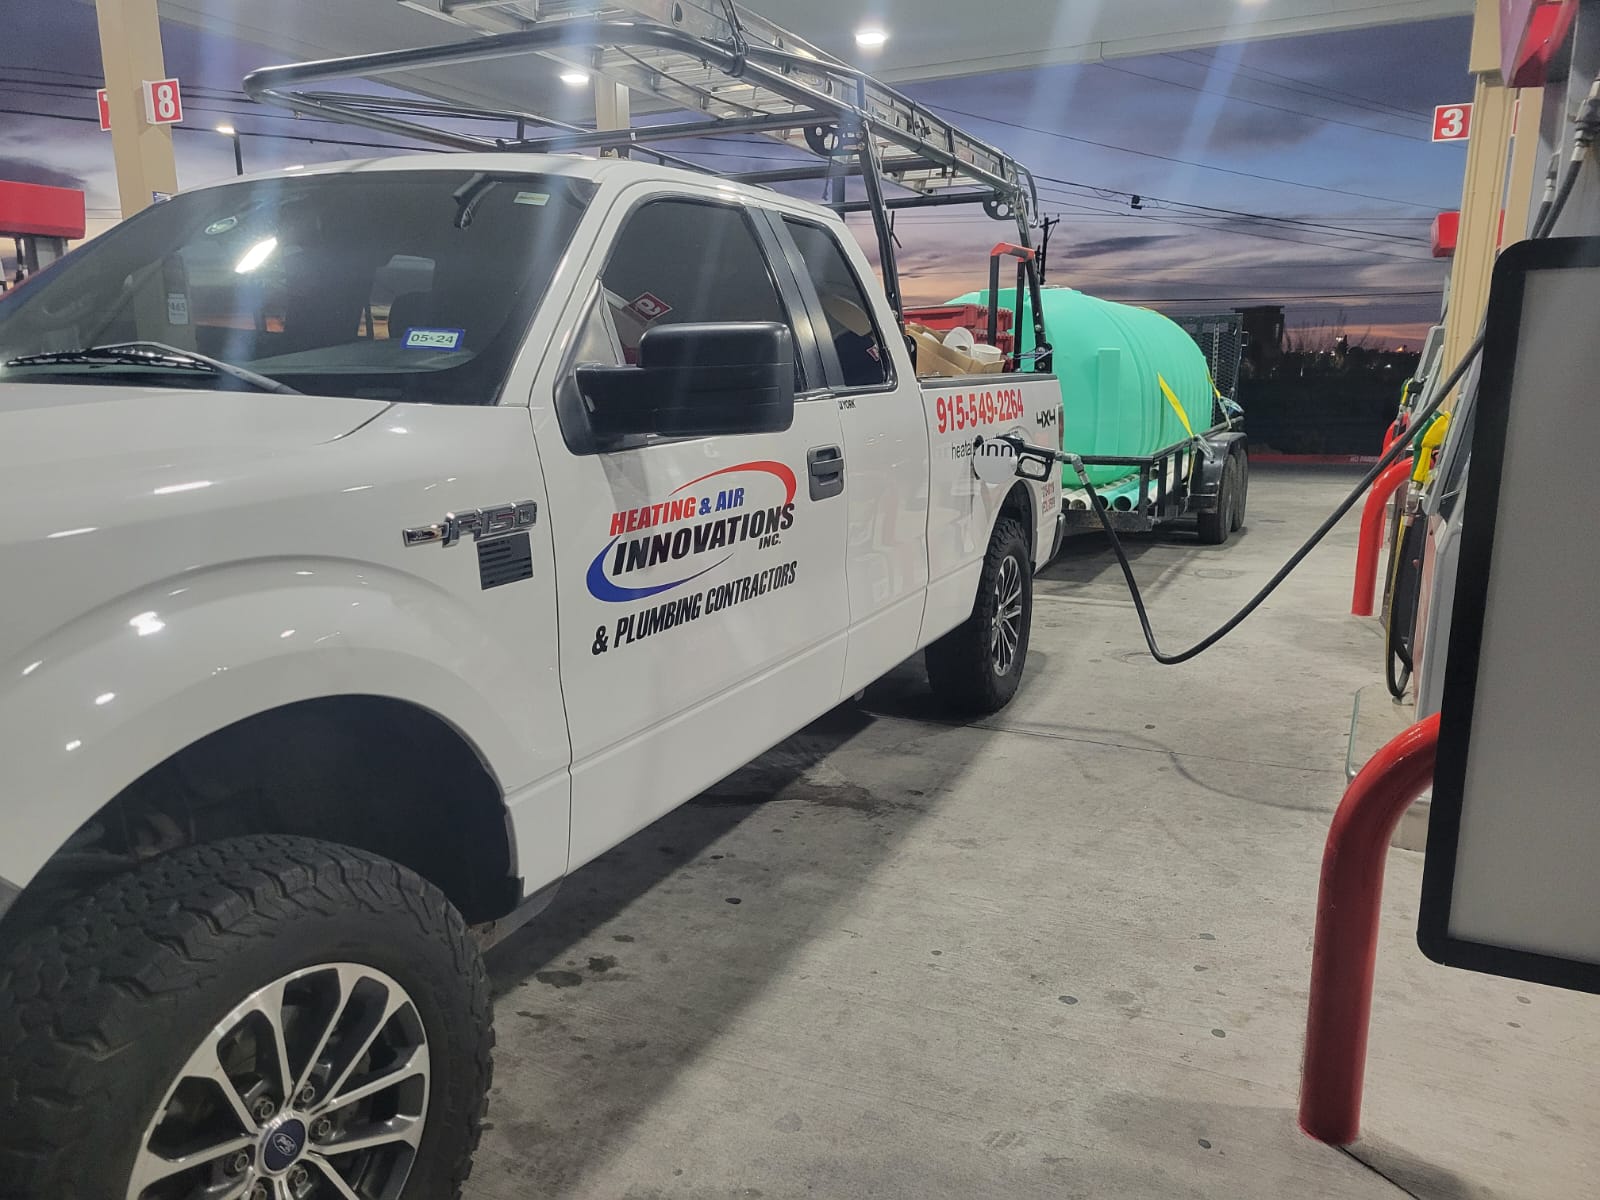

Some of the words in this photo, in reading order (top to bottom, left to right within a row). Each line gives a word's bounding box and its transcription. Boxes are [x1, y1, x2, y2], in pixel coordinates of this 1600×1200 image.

[158, 85, 175, 118] 8
[1441, 108, 1463, 137] 3
[936, 388, 1024, 433] 915-549-2264
[610, 497, 697, 536] HEATING
[698, 498, 711, 515] &
[715, 488, 745, 512] AIR
[612, 503, 795, 576] INNOVATIONS
[758, 534, 782, 550] INC.
[592, 625, 608, 656] &
[613, 592, 703, 648] PLUMBING
[704, 561, 798, 615] CONTRACTORS
